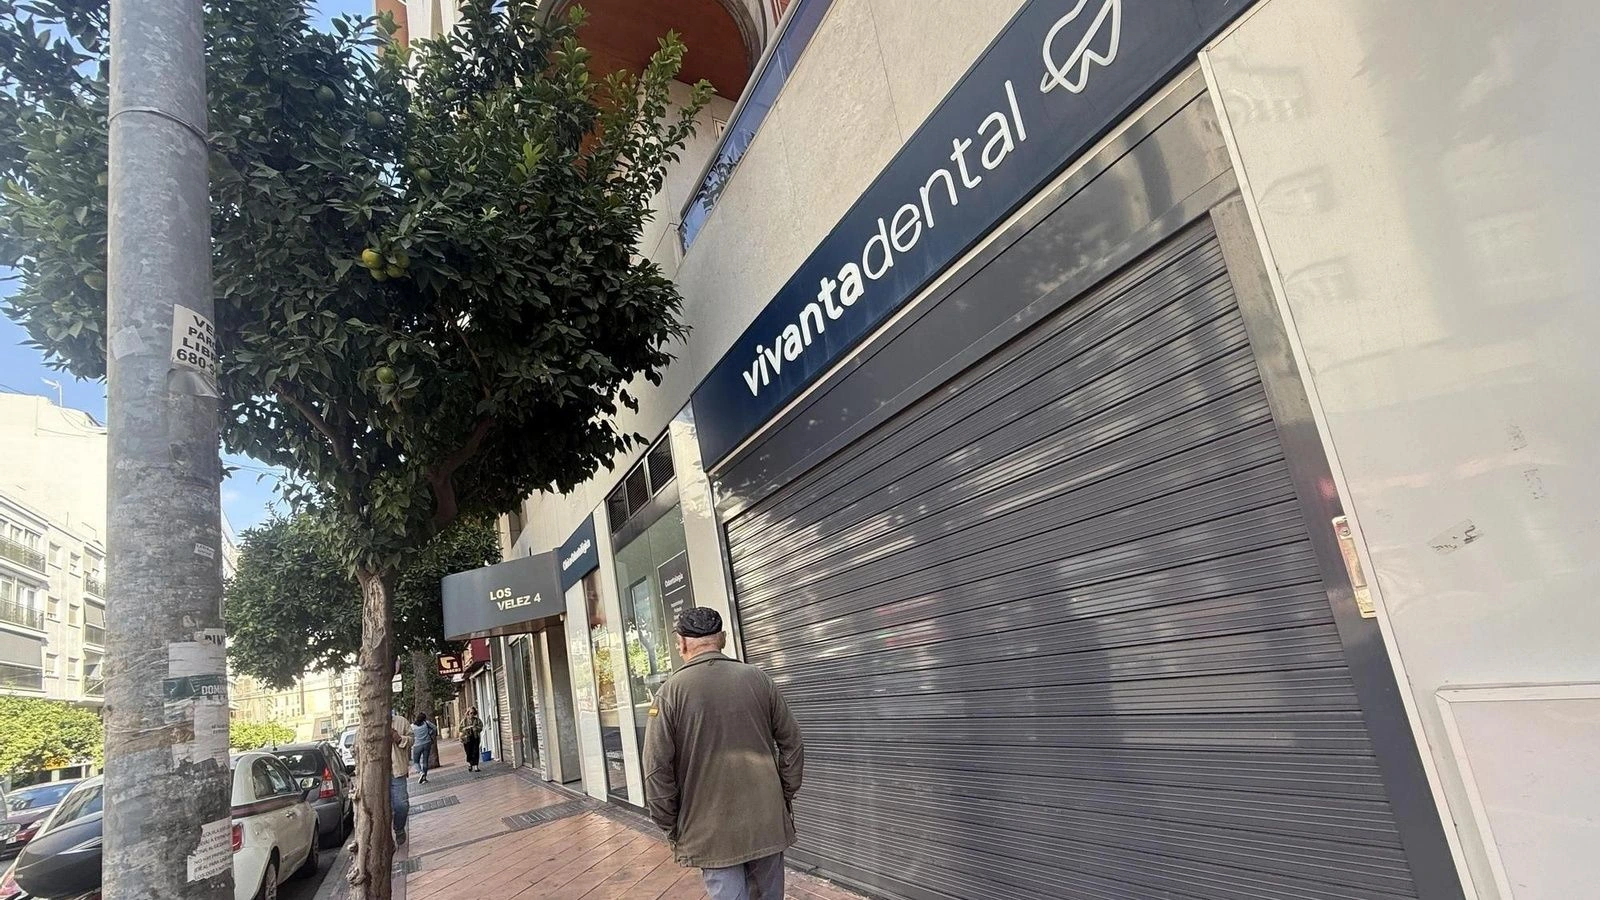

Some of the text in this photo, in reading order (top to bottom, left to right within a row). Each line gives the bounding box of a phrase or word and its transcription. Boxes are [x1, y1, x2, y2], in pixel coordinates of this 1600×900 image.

[489, 587, 512, 601] LOS
[497, 592, 542, 611] VELEZ 4
